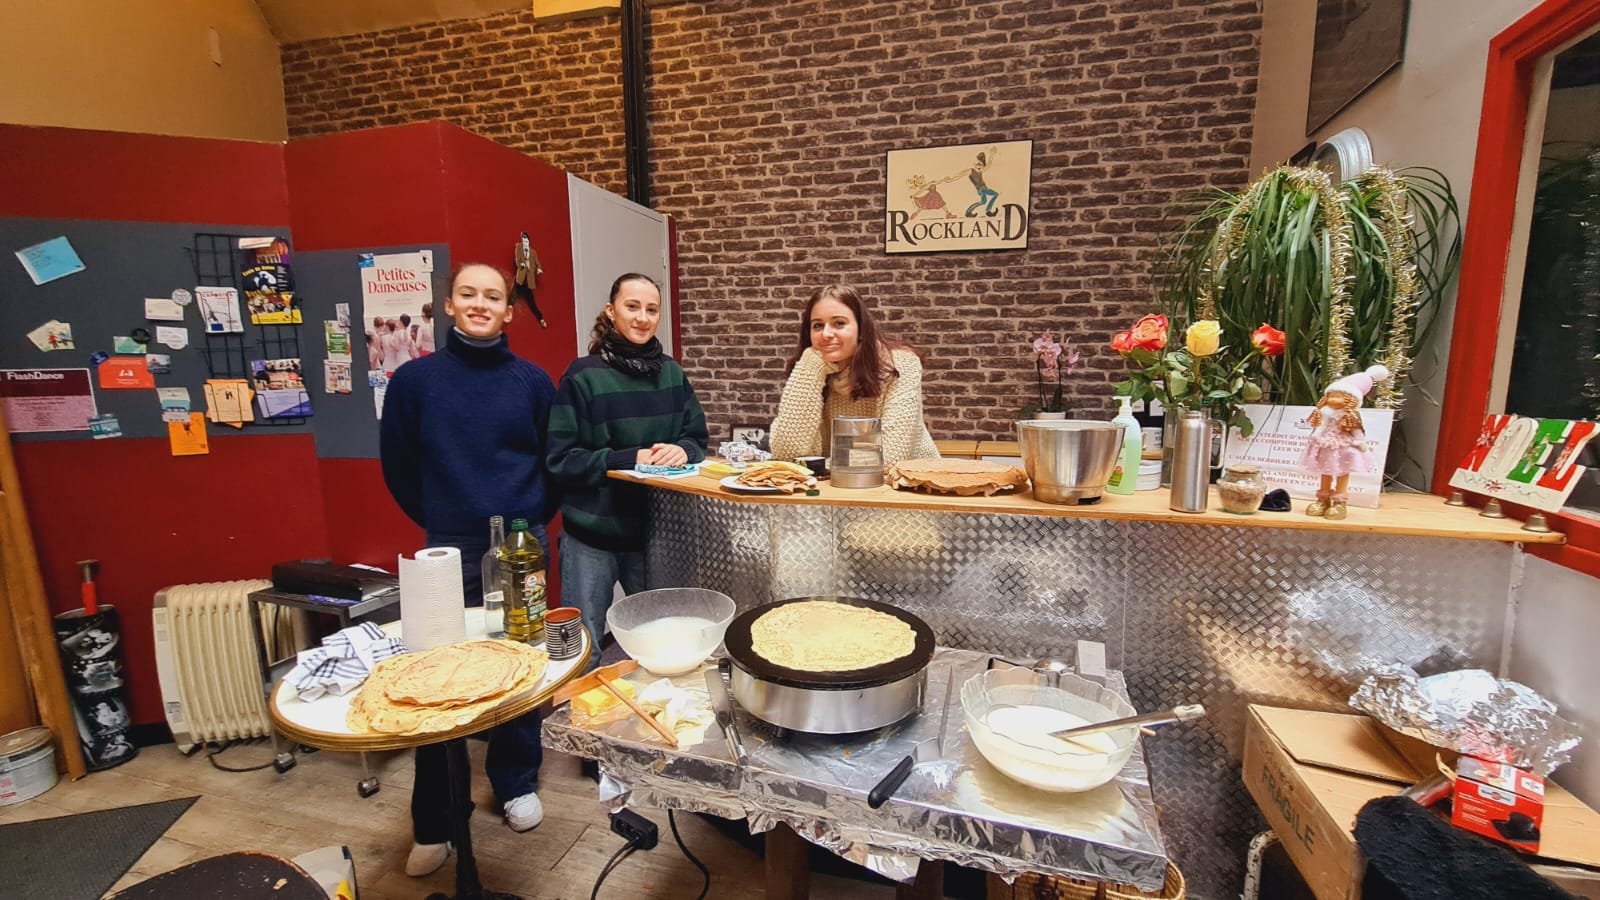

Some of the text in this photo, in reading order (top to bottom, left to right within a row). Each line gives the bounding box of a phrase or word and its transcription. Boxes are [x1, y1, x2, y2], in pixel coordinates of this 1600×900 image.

[887, 203, 1027, 245] ROCKLAND
[376, 268, 416, 282] Petites
[367, 280, 427, 295] Danseuses
[7, 371, 65, 380] FlashDance
[1262, 766, 1315, 854] FRAGILE
